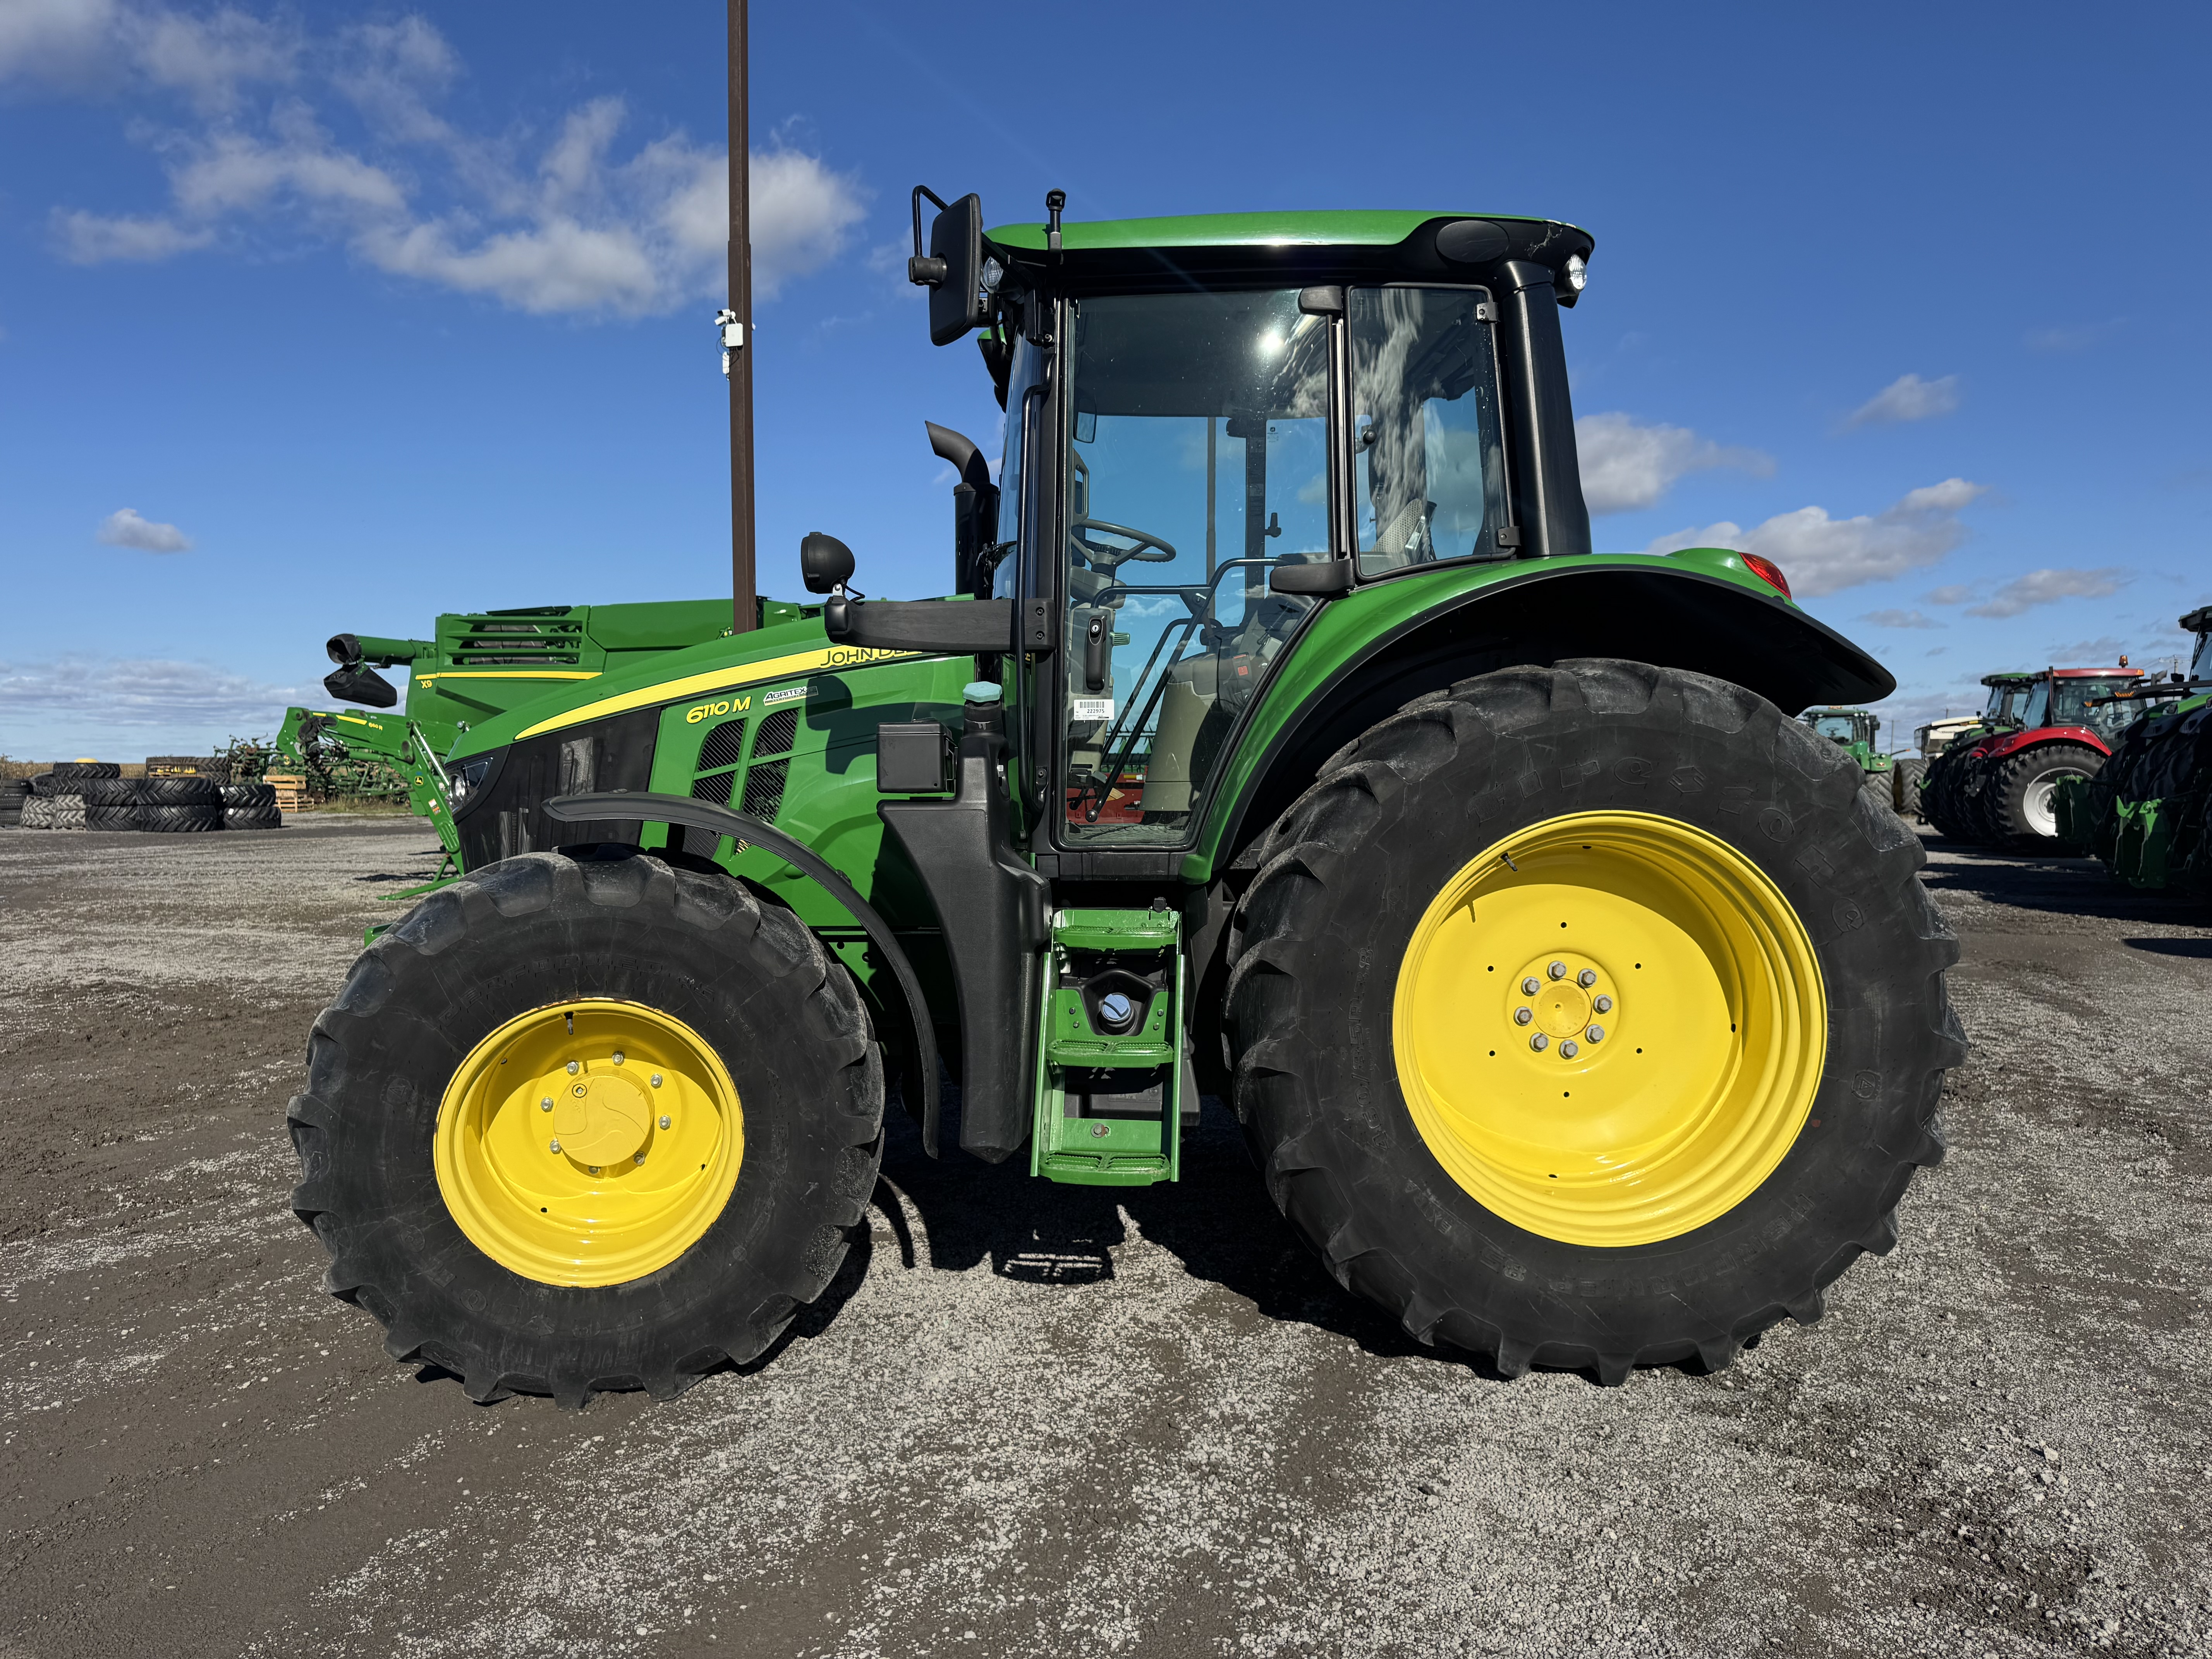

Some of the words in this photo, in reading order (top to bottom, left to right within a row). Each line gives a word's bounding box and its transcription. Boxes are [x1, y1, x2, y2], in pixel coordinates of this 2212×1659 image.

[820, 648, 873, 666] JOHN
[421, 680, 433, 689] X9
[765, 688, 806, 701] AGRITEX
[686, 701, 730, 724] 6110
[732, 696, 752, 713] M
[437, 952, 663, 1027] PERFORMER
[723, 1004, 756, 1040] EXTRA
[1404, 1181, 1452, 1235] EXTRA
[1549, 1194, 1815, 1297] PERFORMER
